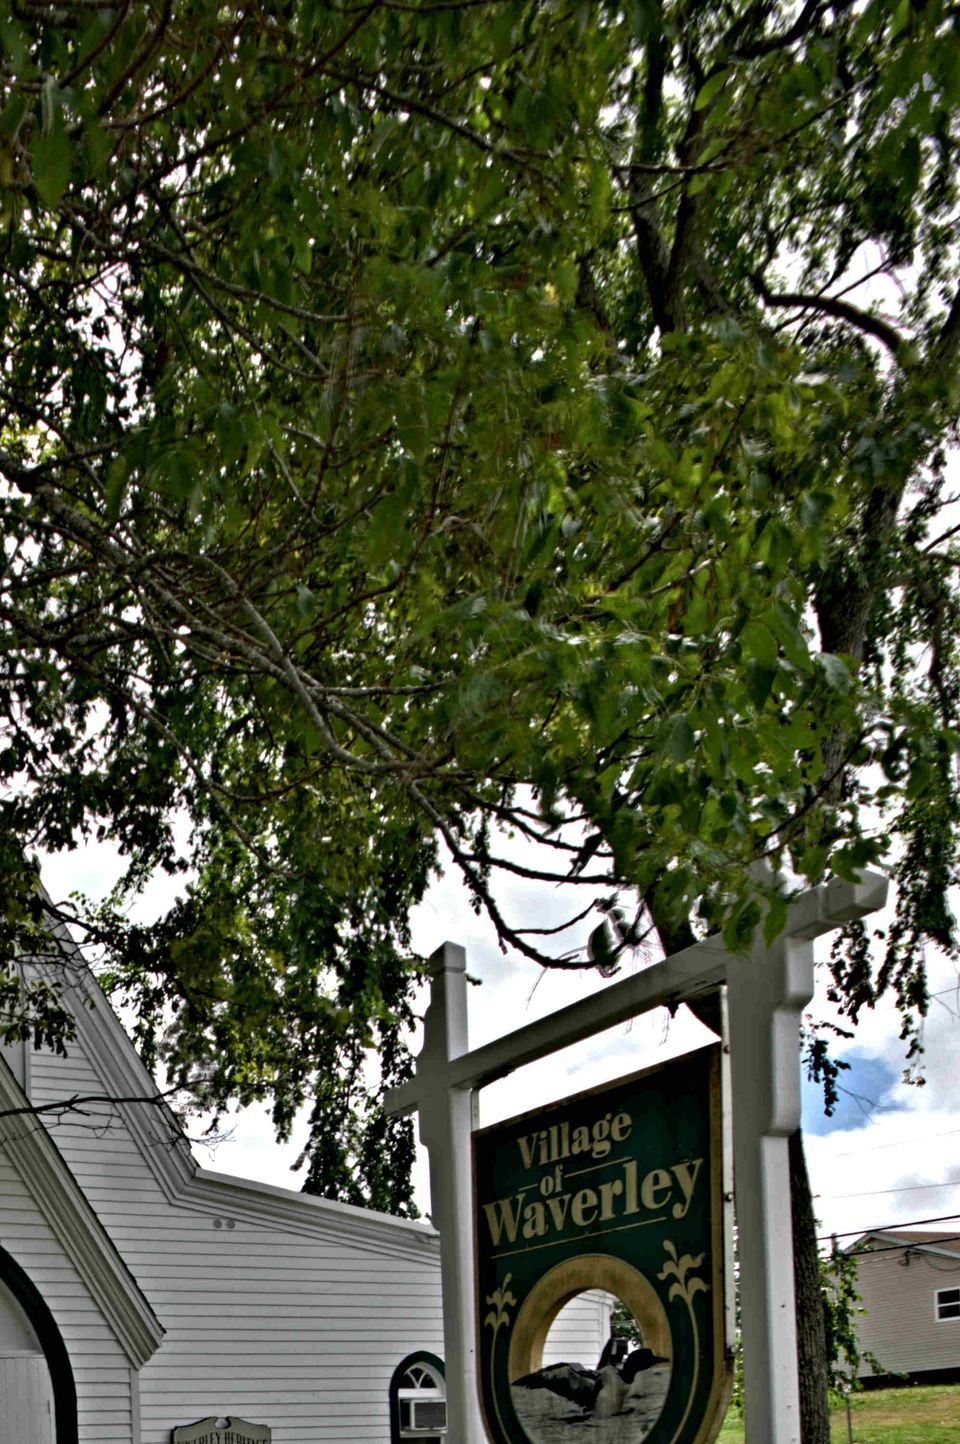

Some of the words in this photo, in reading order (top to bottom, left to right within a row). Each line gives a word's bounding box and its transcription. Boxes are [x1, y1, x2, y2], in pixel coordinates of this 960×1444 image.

[516, 1109, 632, 1170] Village
[482, 1158, 704, 1247] Waverley
[539, 1165, 564, 1197] of
